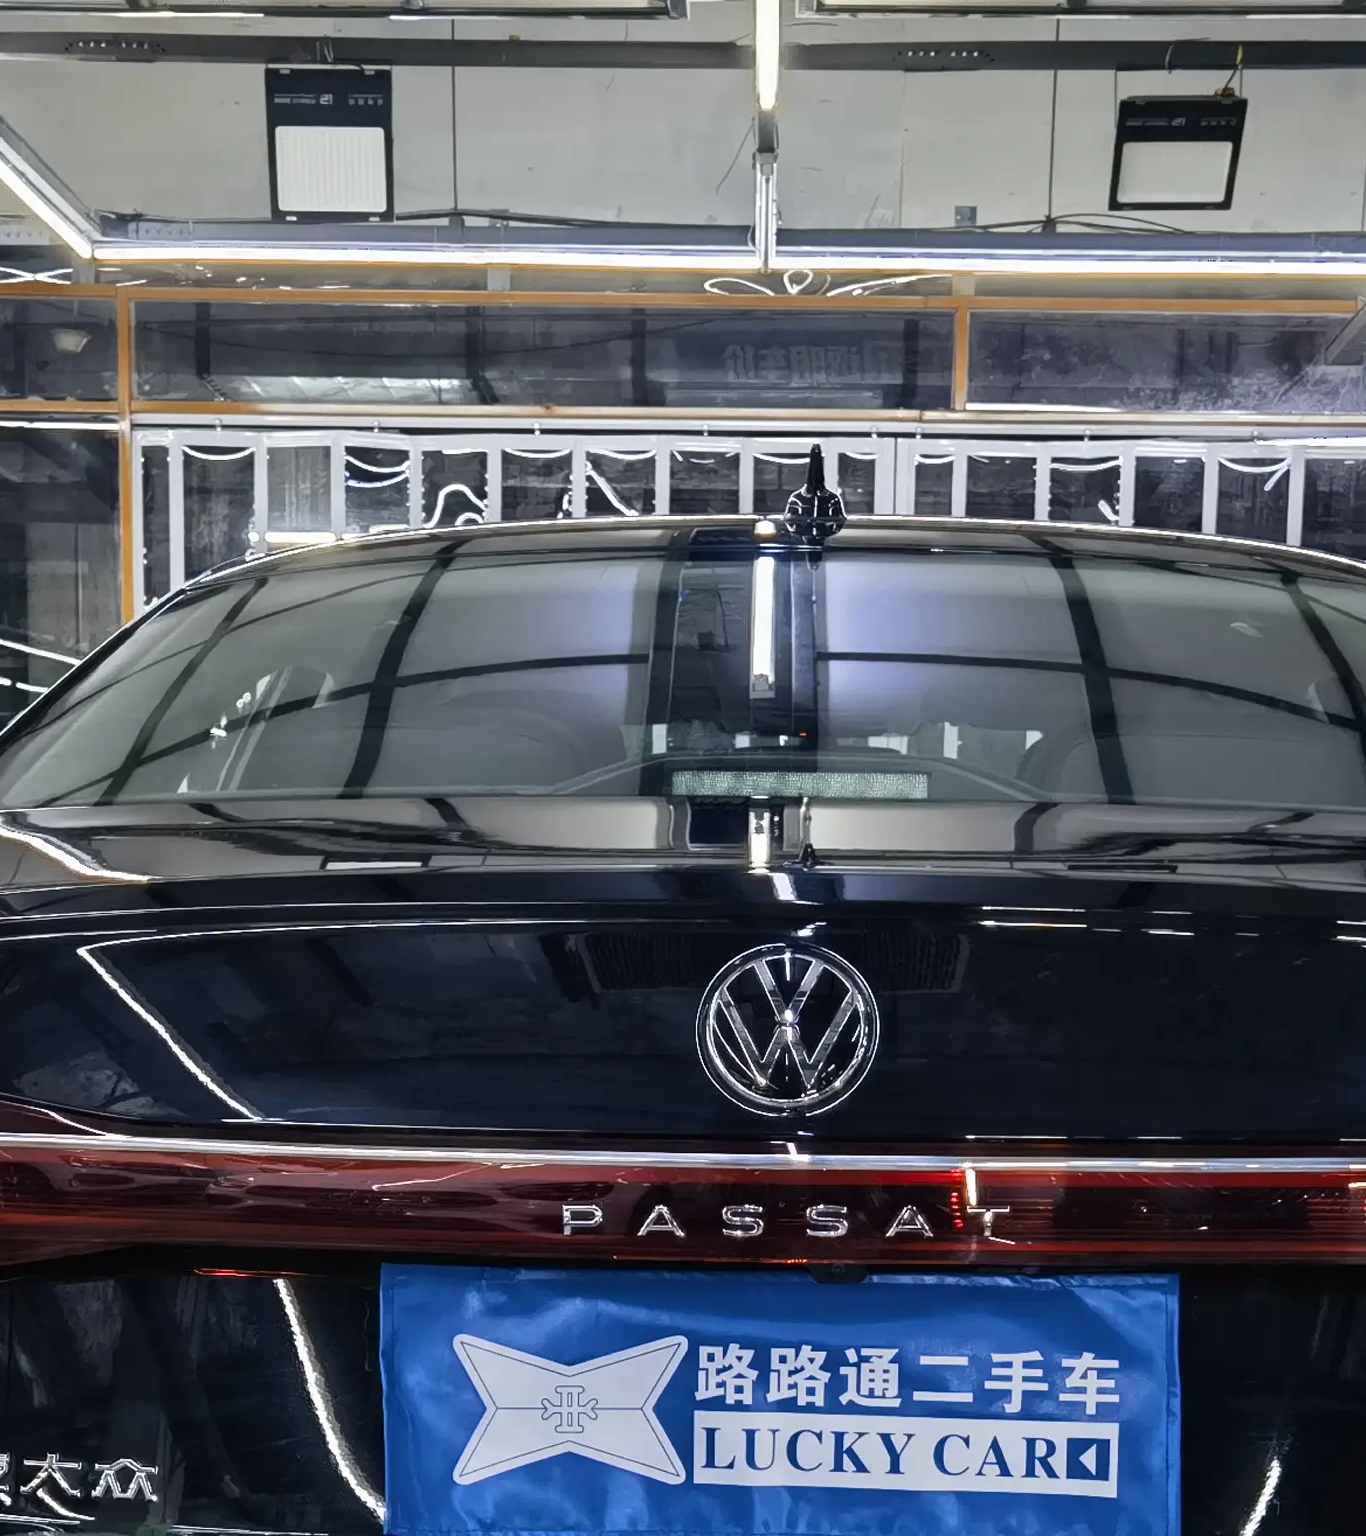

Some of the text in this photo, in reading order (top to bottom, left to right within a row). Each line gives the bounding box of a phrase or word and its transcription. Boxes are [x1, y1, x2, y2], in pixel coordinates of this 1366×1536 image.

[562, 1203, 1011, 1237] PASSAT
[694, 1343, 1120, 1416] 路路通二手车
[700, 1427, 1061, 1479] LUCKY CAR
